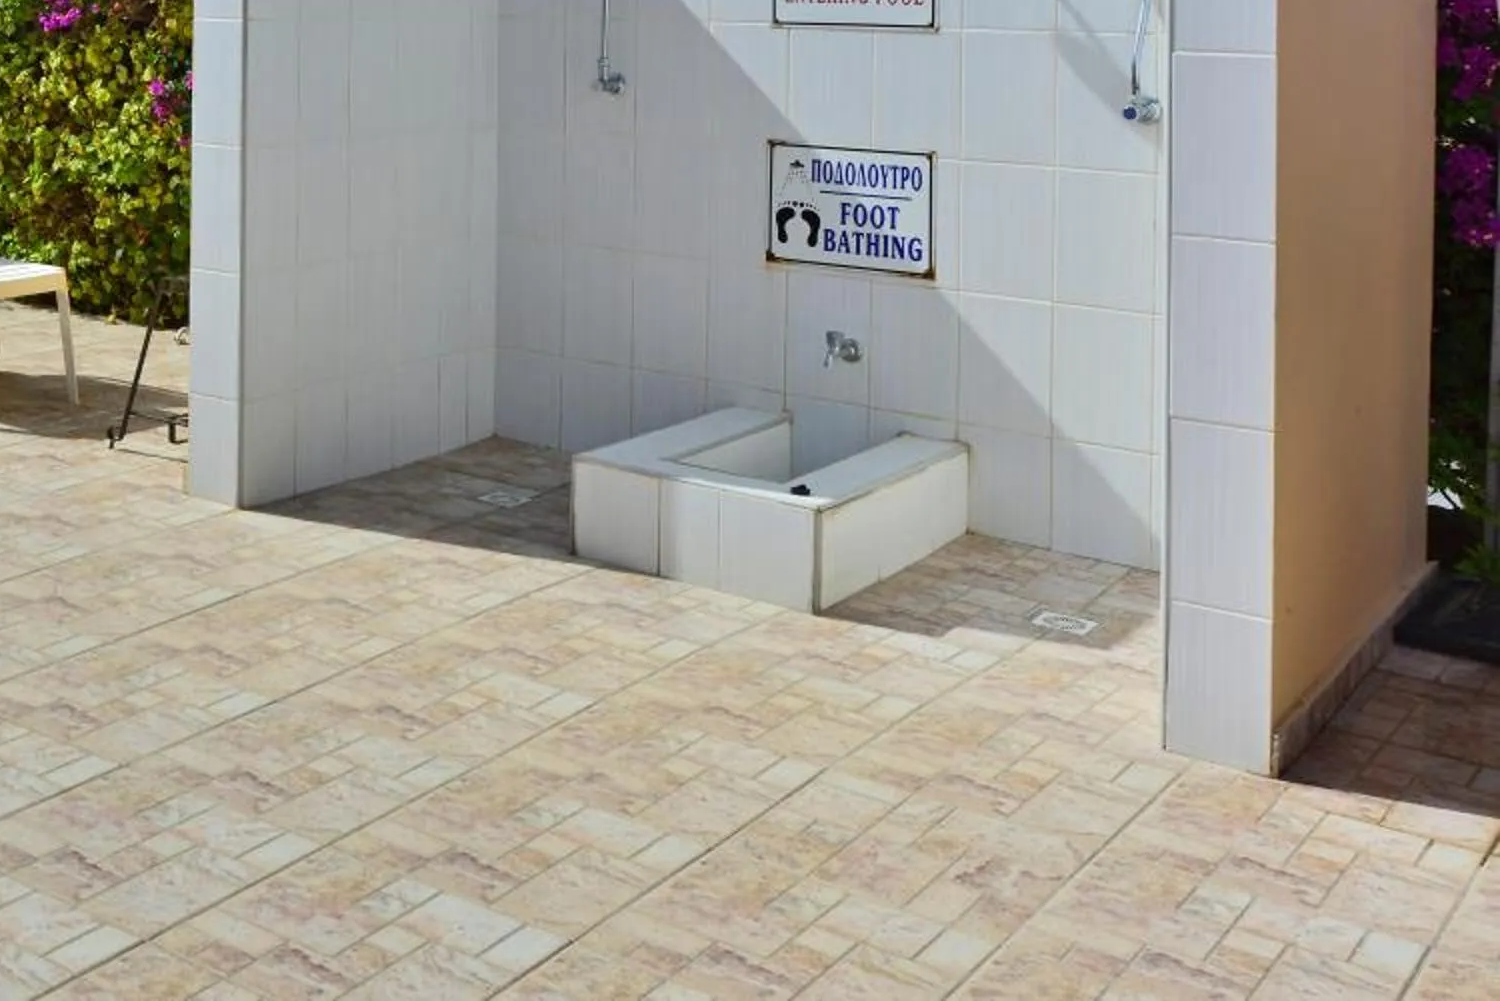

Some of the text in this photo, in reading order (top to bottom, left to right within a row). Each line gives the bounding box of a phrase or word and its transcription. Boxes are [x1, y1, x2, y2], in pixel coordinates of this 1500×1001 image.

[811, 159, 923, 191] ΠΟΔΟΛΟΥΤΡΟ
[840, 202, 900, 229] FOOT
[823, 229, 923, 261] BATHING
